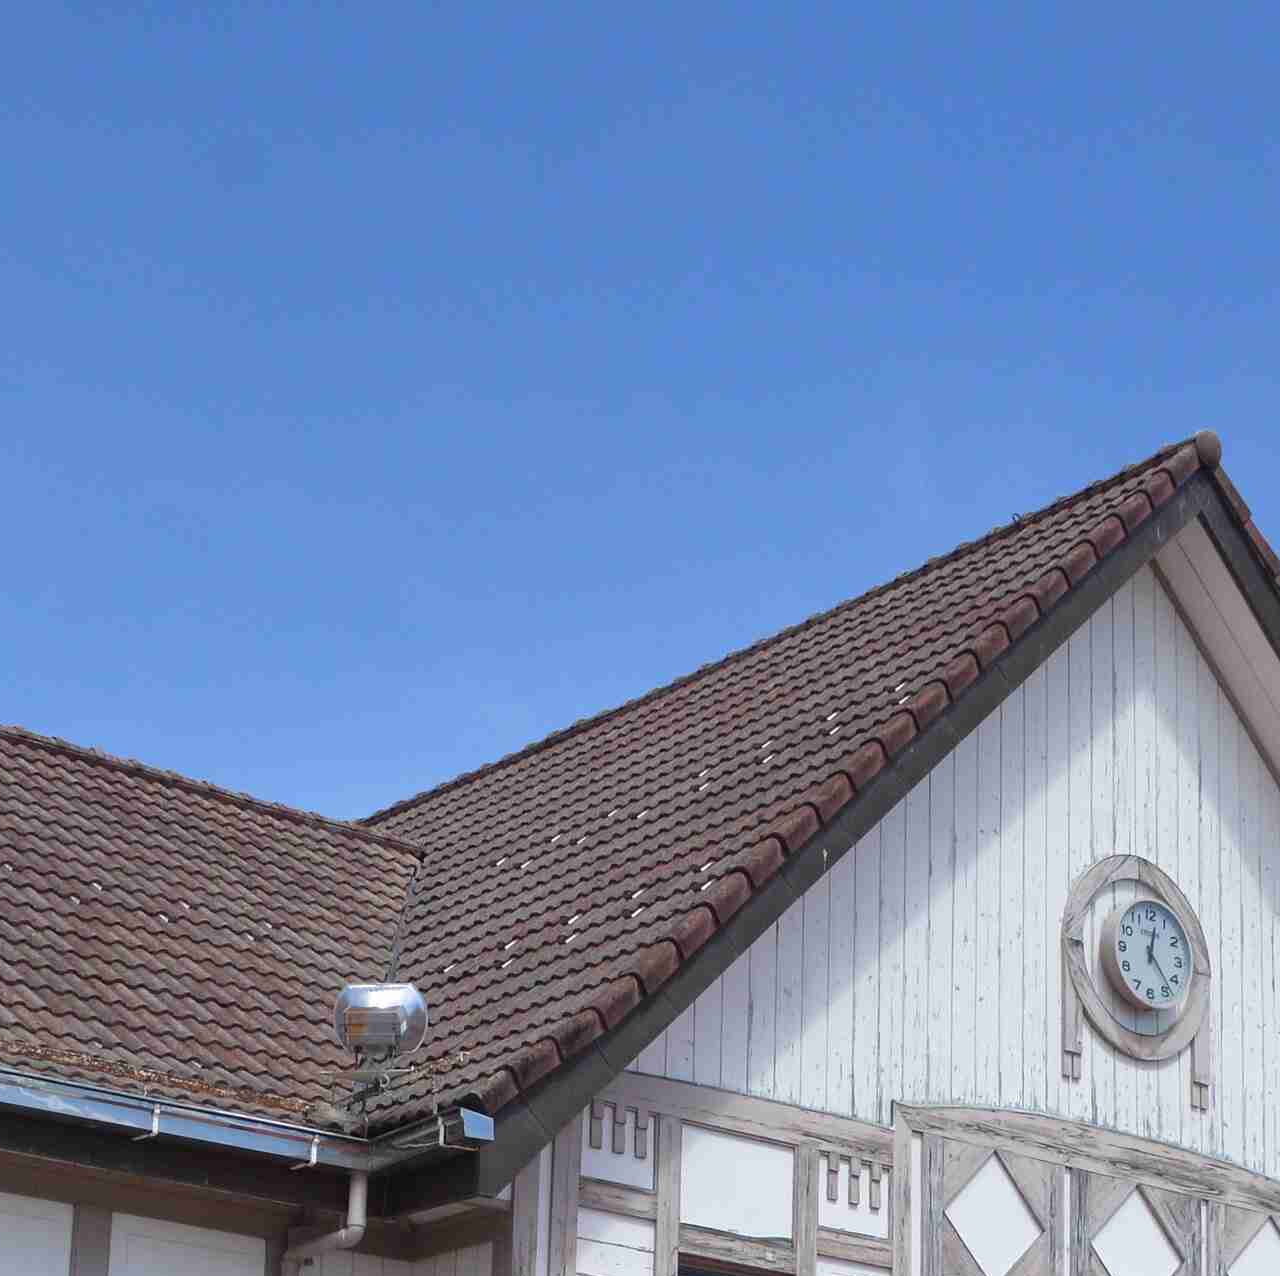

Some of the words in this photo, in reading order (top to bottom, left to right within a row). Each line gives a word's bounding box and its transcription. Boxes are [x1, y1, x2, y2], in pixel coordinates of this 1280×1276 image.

[1130, 912, 1141, 926] 11
[1145, 909, 1157, 922] 12
[1121, 924, 1134, 937] 10
[1118, 940, 1128, 952] 9
[1170, 936, 1179, 948] 2
[1121, 960, 1131, 972] 8
[1174, 956, 1183, 969] 3
[1133, 978, 1142, 990] 7
[1170, 974, 1179, 986] 4
[1146, 988, 1155, 1000] 6
[1160, 985, 1170, 998] 5
